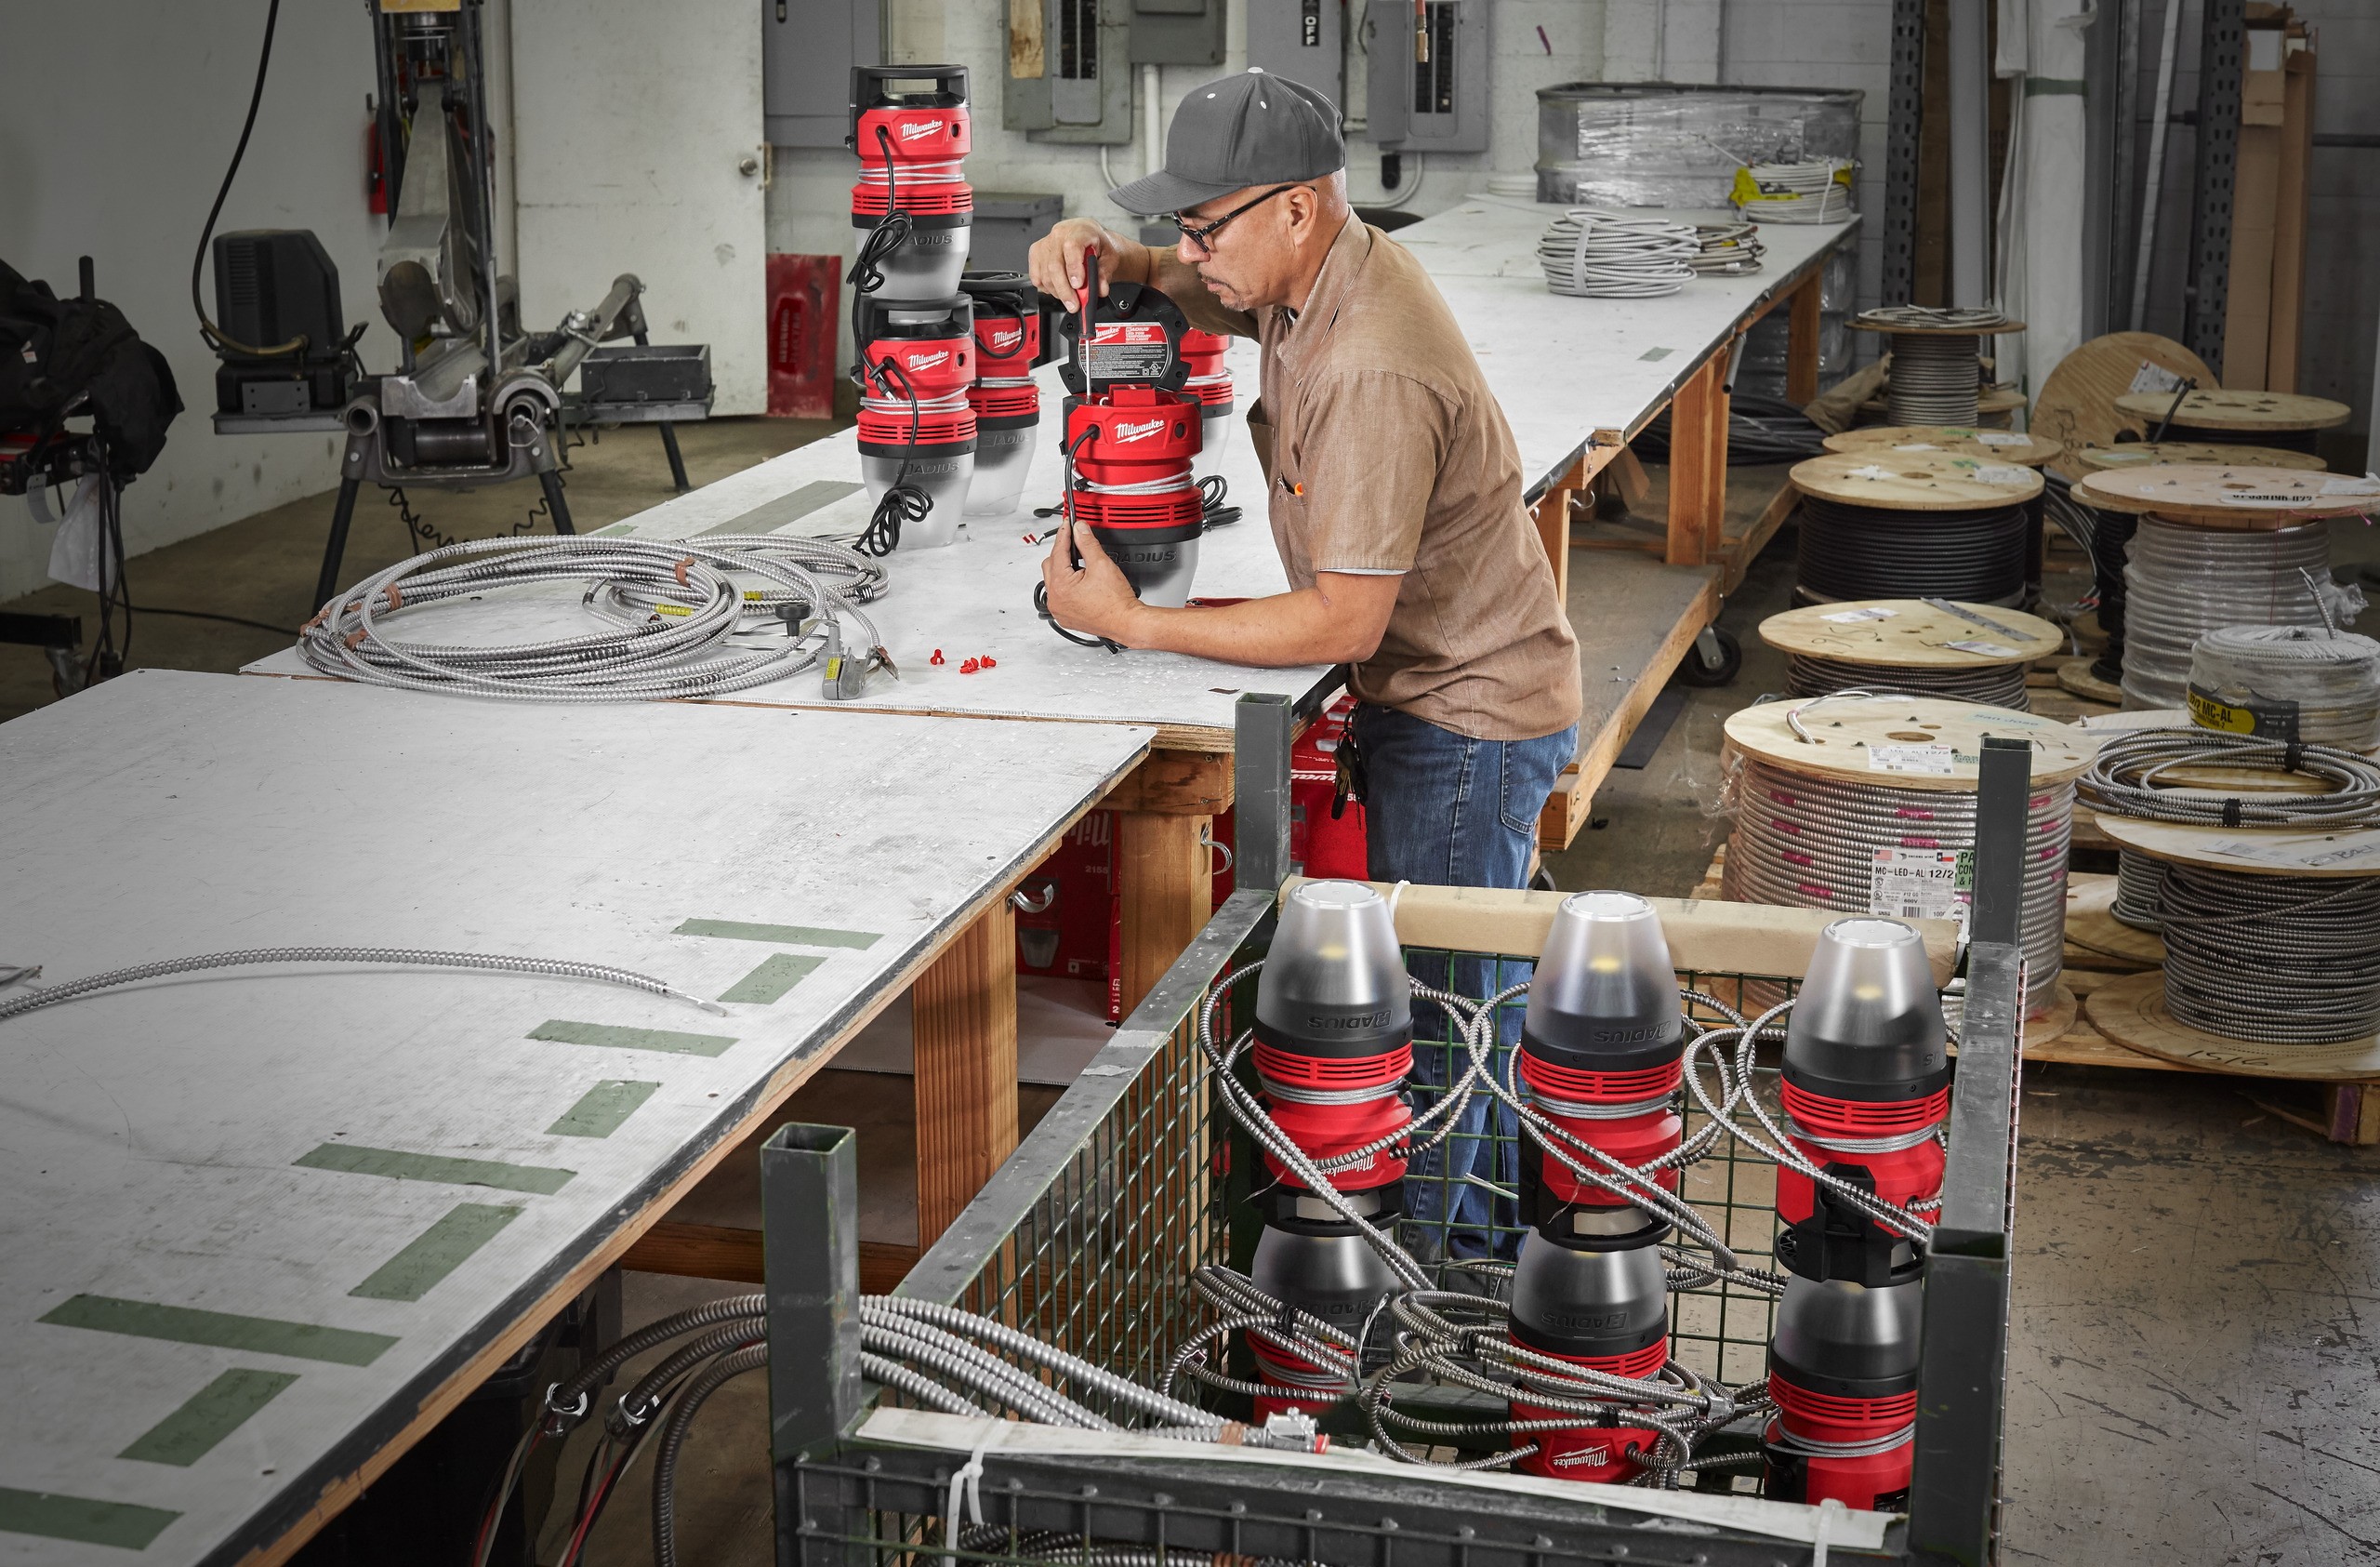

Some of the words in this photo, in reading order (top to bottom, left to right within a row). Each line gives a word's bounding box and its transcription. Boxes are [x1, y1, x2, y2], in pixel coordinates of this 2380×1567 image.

[1305, 16, 1316, 45] OFF
[900, 120, 944, 137] Milwaukee
[907, 234, 954, 246] ADIUS
[992, 327, 1022, 344] Milwauk
[907, 351, 948, 367] Milwaukee
[1115, 419, 1165, 439] Milwaukee
[2202, 701, 2233, 724] MC-AL
[1929, 869, 1954, 879] 12/2
[1308, 1009, 1392, 1029] RADIUS
[1594, 1021, 1672, 1042] RADIUS
[1322, 1155, 1378, 1177] Milwaukee
[1541, 1311, 1627, 1330] RADIUS
[1554, 1451, 1609, 1469] Milwaukee
